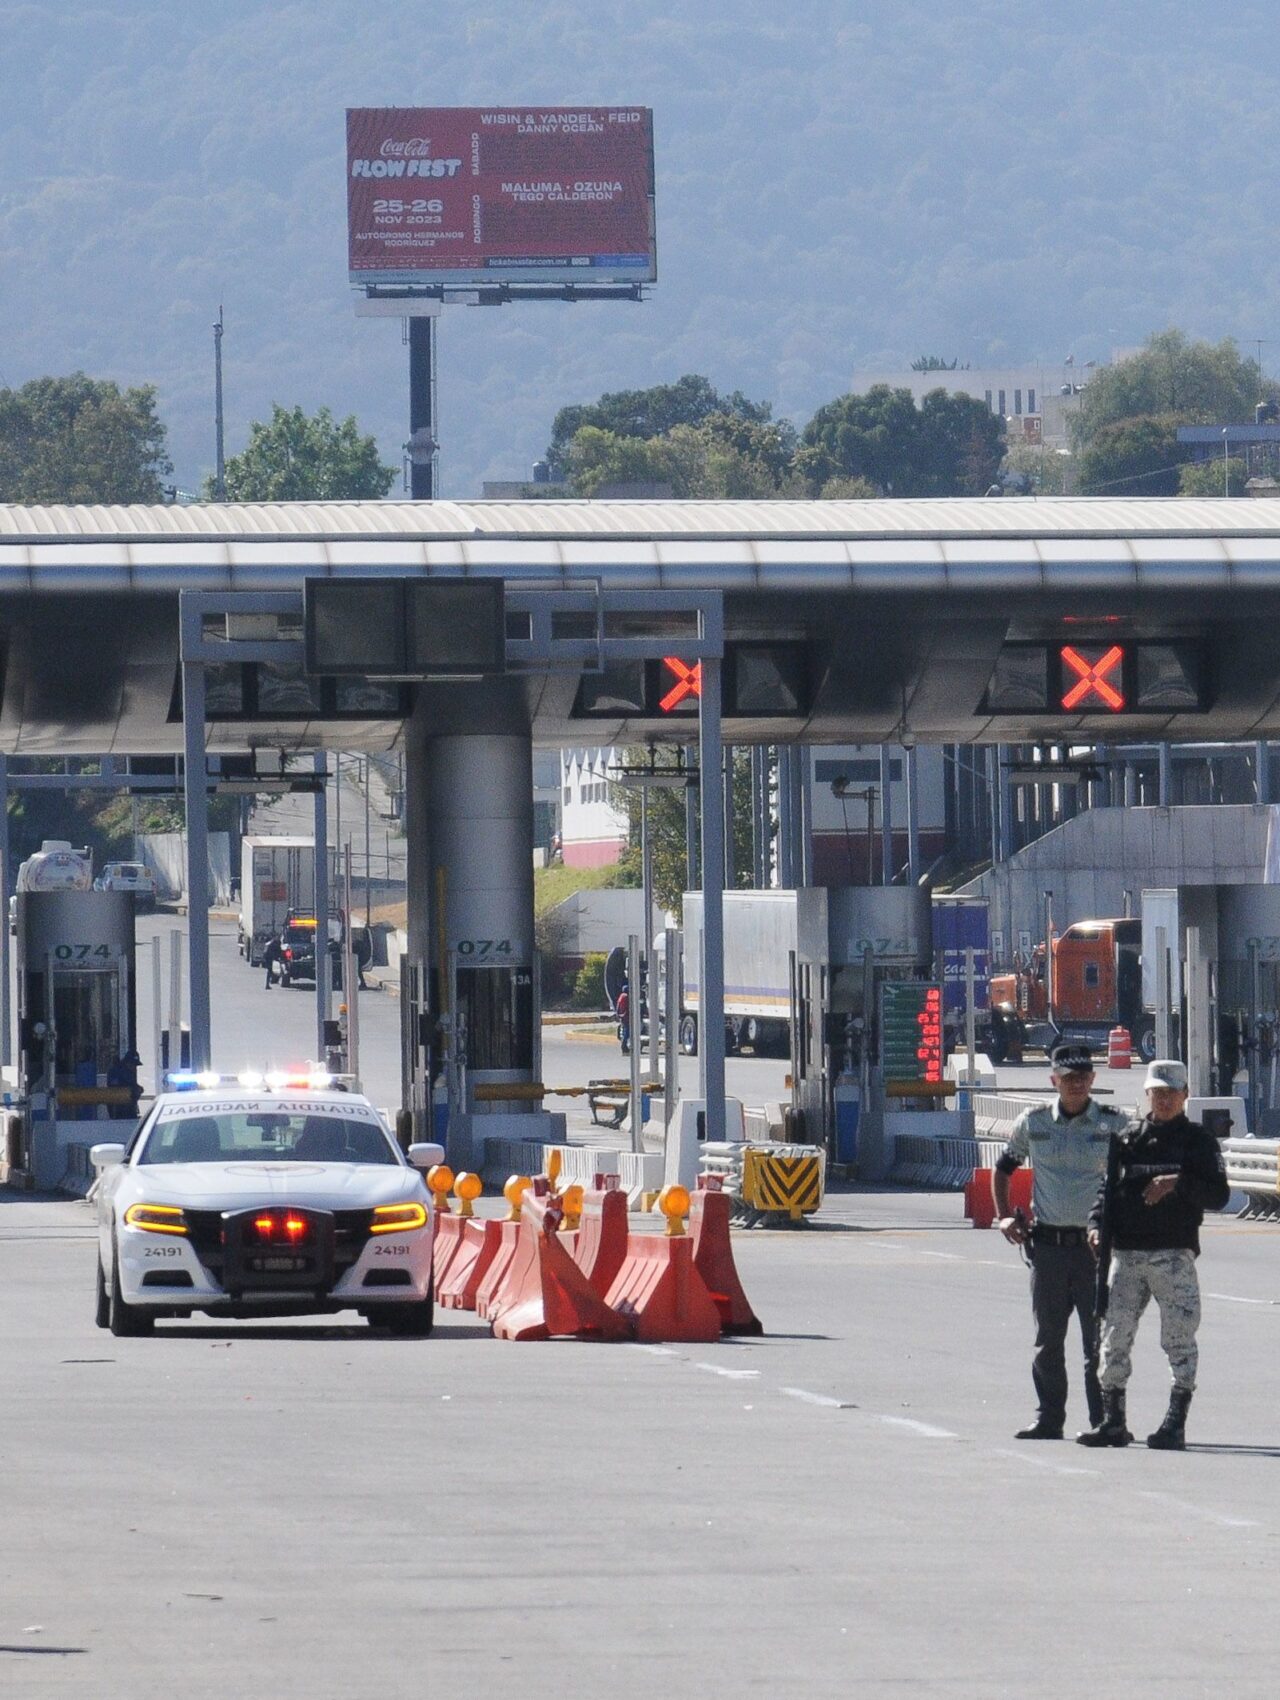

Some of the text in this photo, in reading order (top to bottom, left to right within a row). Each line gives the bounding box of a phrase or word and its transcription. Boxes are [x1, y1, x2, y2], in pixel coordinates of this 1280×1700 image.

[481, 112, 641, 124] WISIN & YANDEL FEID
[518, 124, 603, 133] DANNY OCEAN
[352, 159, 462, 178] FLOW FEST
[502, 182, 623, 192] MALUMA OZUNA
[512, 192, 544, 200] TEGO
[373, 199, 443, 213] 25-26
[374, 215, 442, 224] NOV 2023
[55, 944, 112, 959] 074
[458, 940, 512, 955] 074
[144, 1247, 182, 1257] 24191
[375, 1245, 410, 1256] 24191
